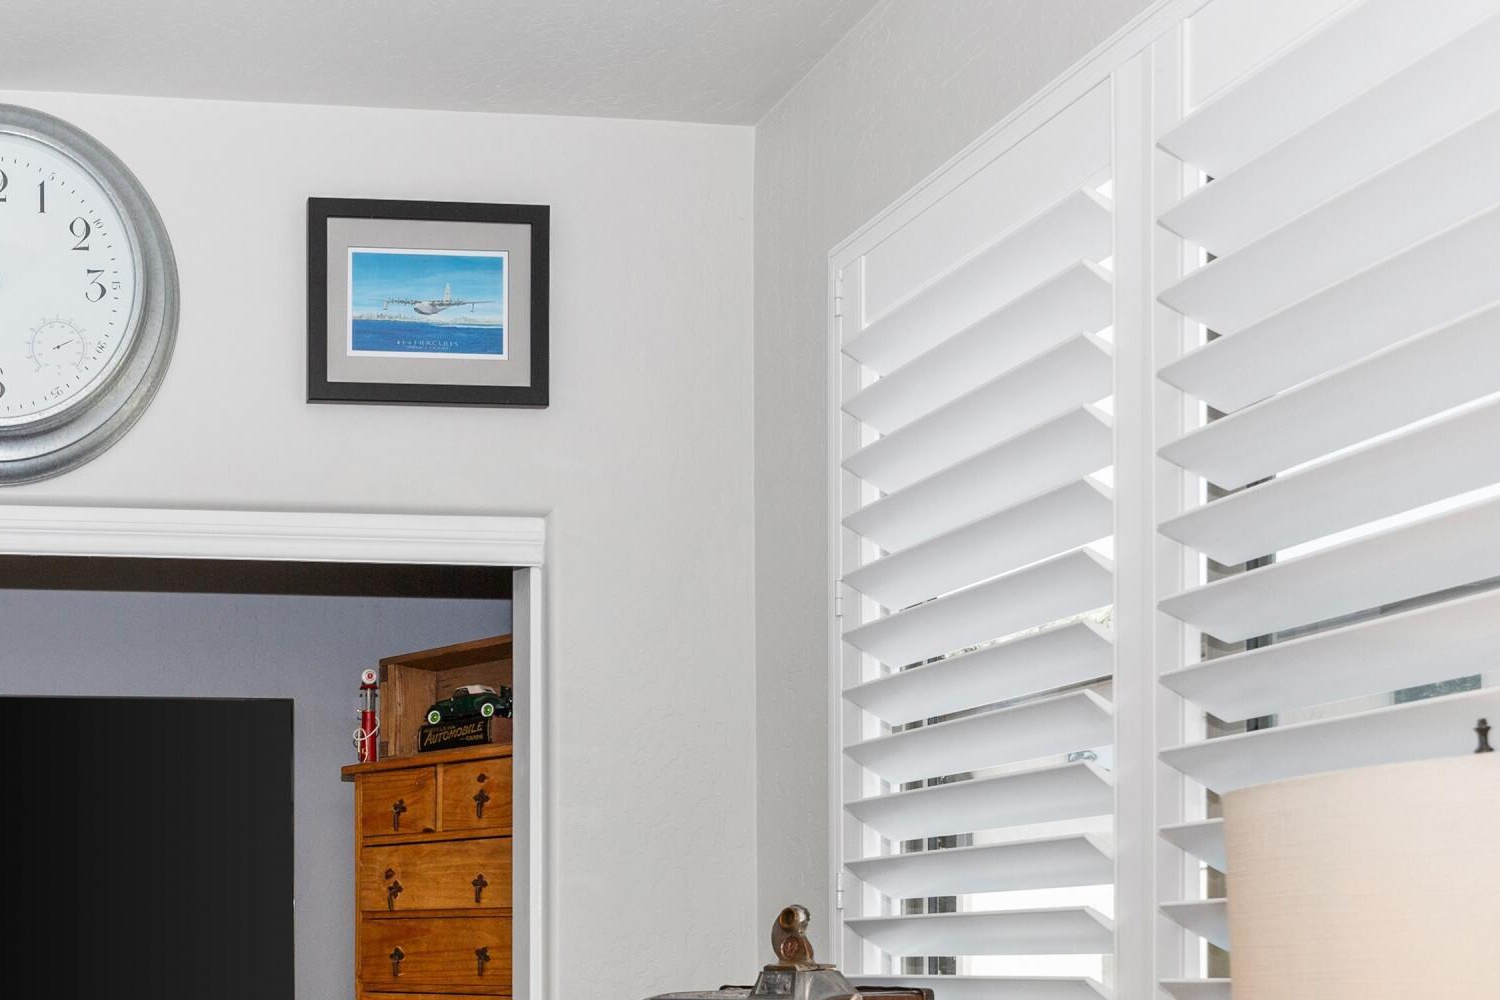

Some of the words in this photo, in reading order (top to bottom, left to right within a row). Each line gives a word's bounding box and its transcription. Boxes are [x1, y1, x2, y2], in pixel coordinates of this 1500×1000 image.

[37, 180, 46, 214] 1
[69, 216, 91, 251] 2
[85, 268, 106, 302] 3
[424, 721, 485, 747] AUTOMOBILE
